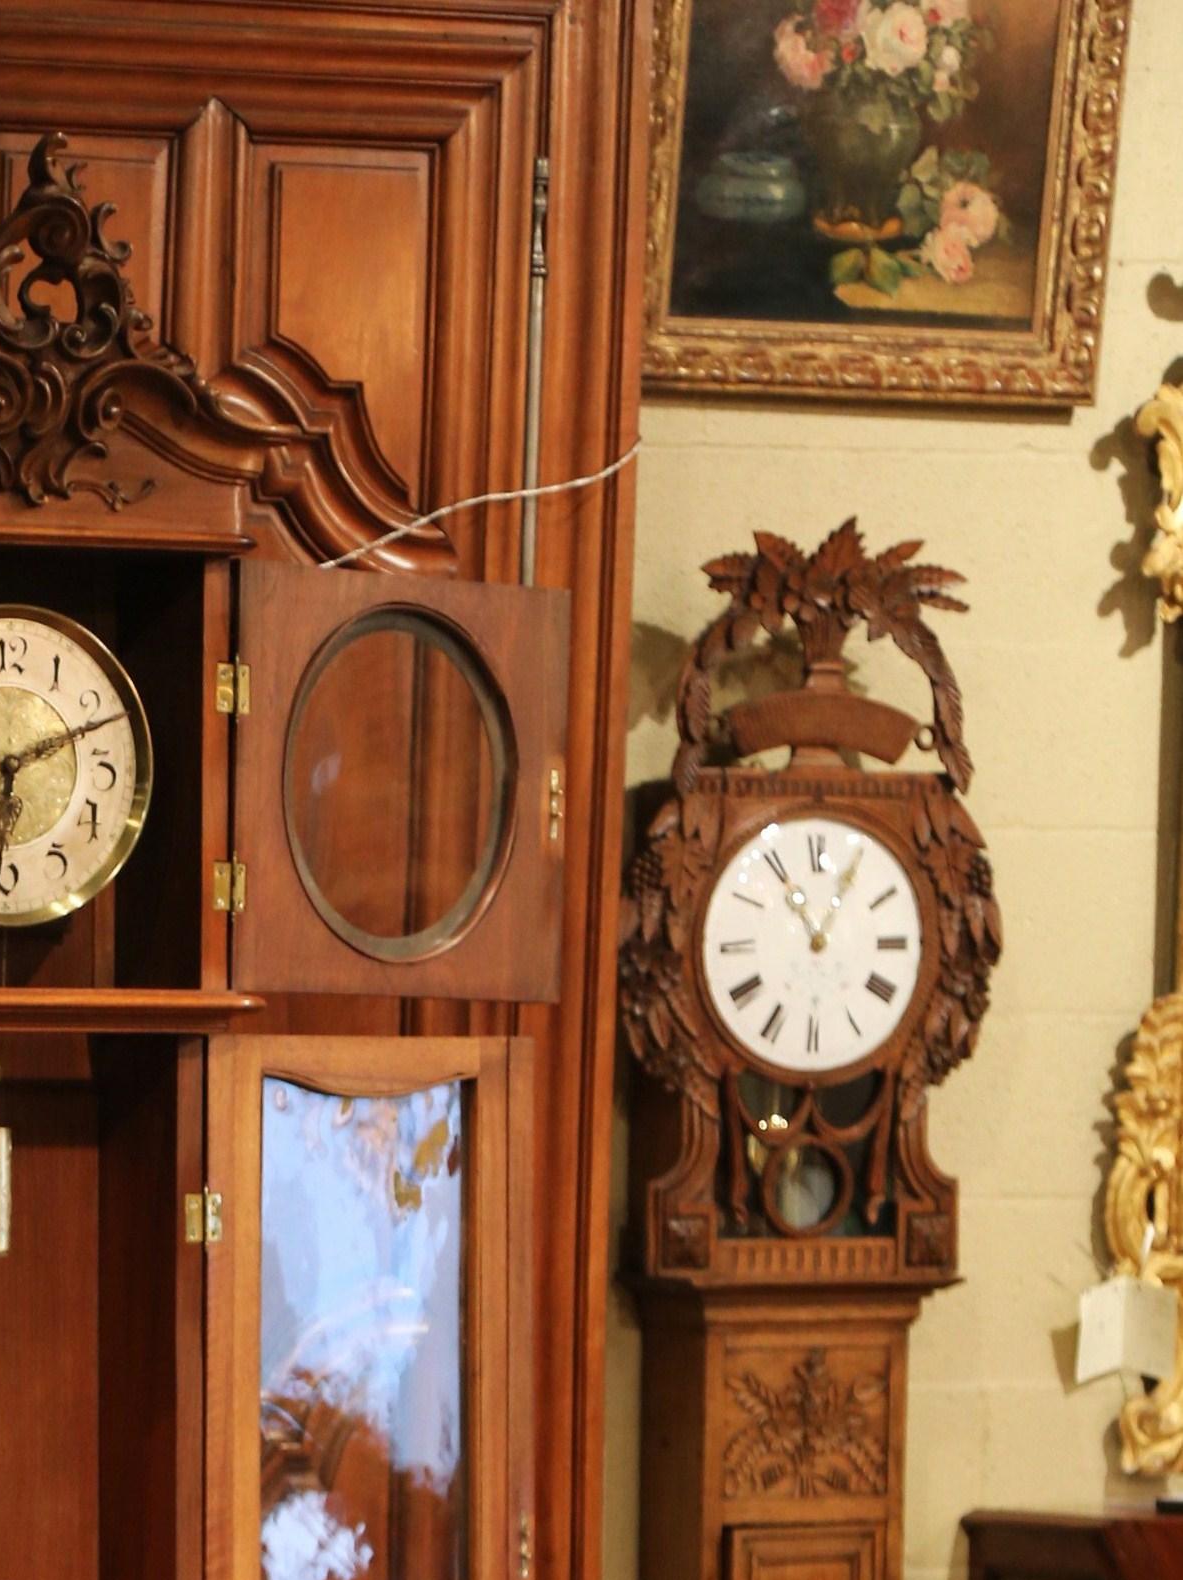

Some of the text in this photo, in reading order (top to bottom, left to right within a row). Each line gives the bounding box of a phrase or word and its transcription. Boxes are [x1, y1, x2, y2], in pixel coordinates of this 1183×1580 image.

[49, 654, 61, 691] 1
[77, 798, 102, 843] 4
[43, 842, 68, 879] 5
